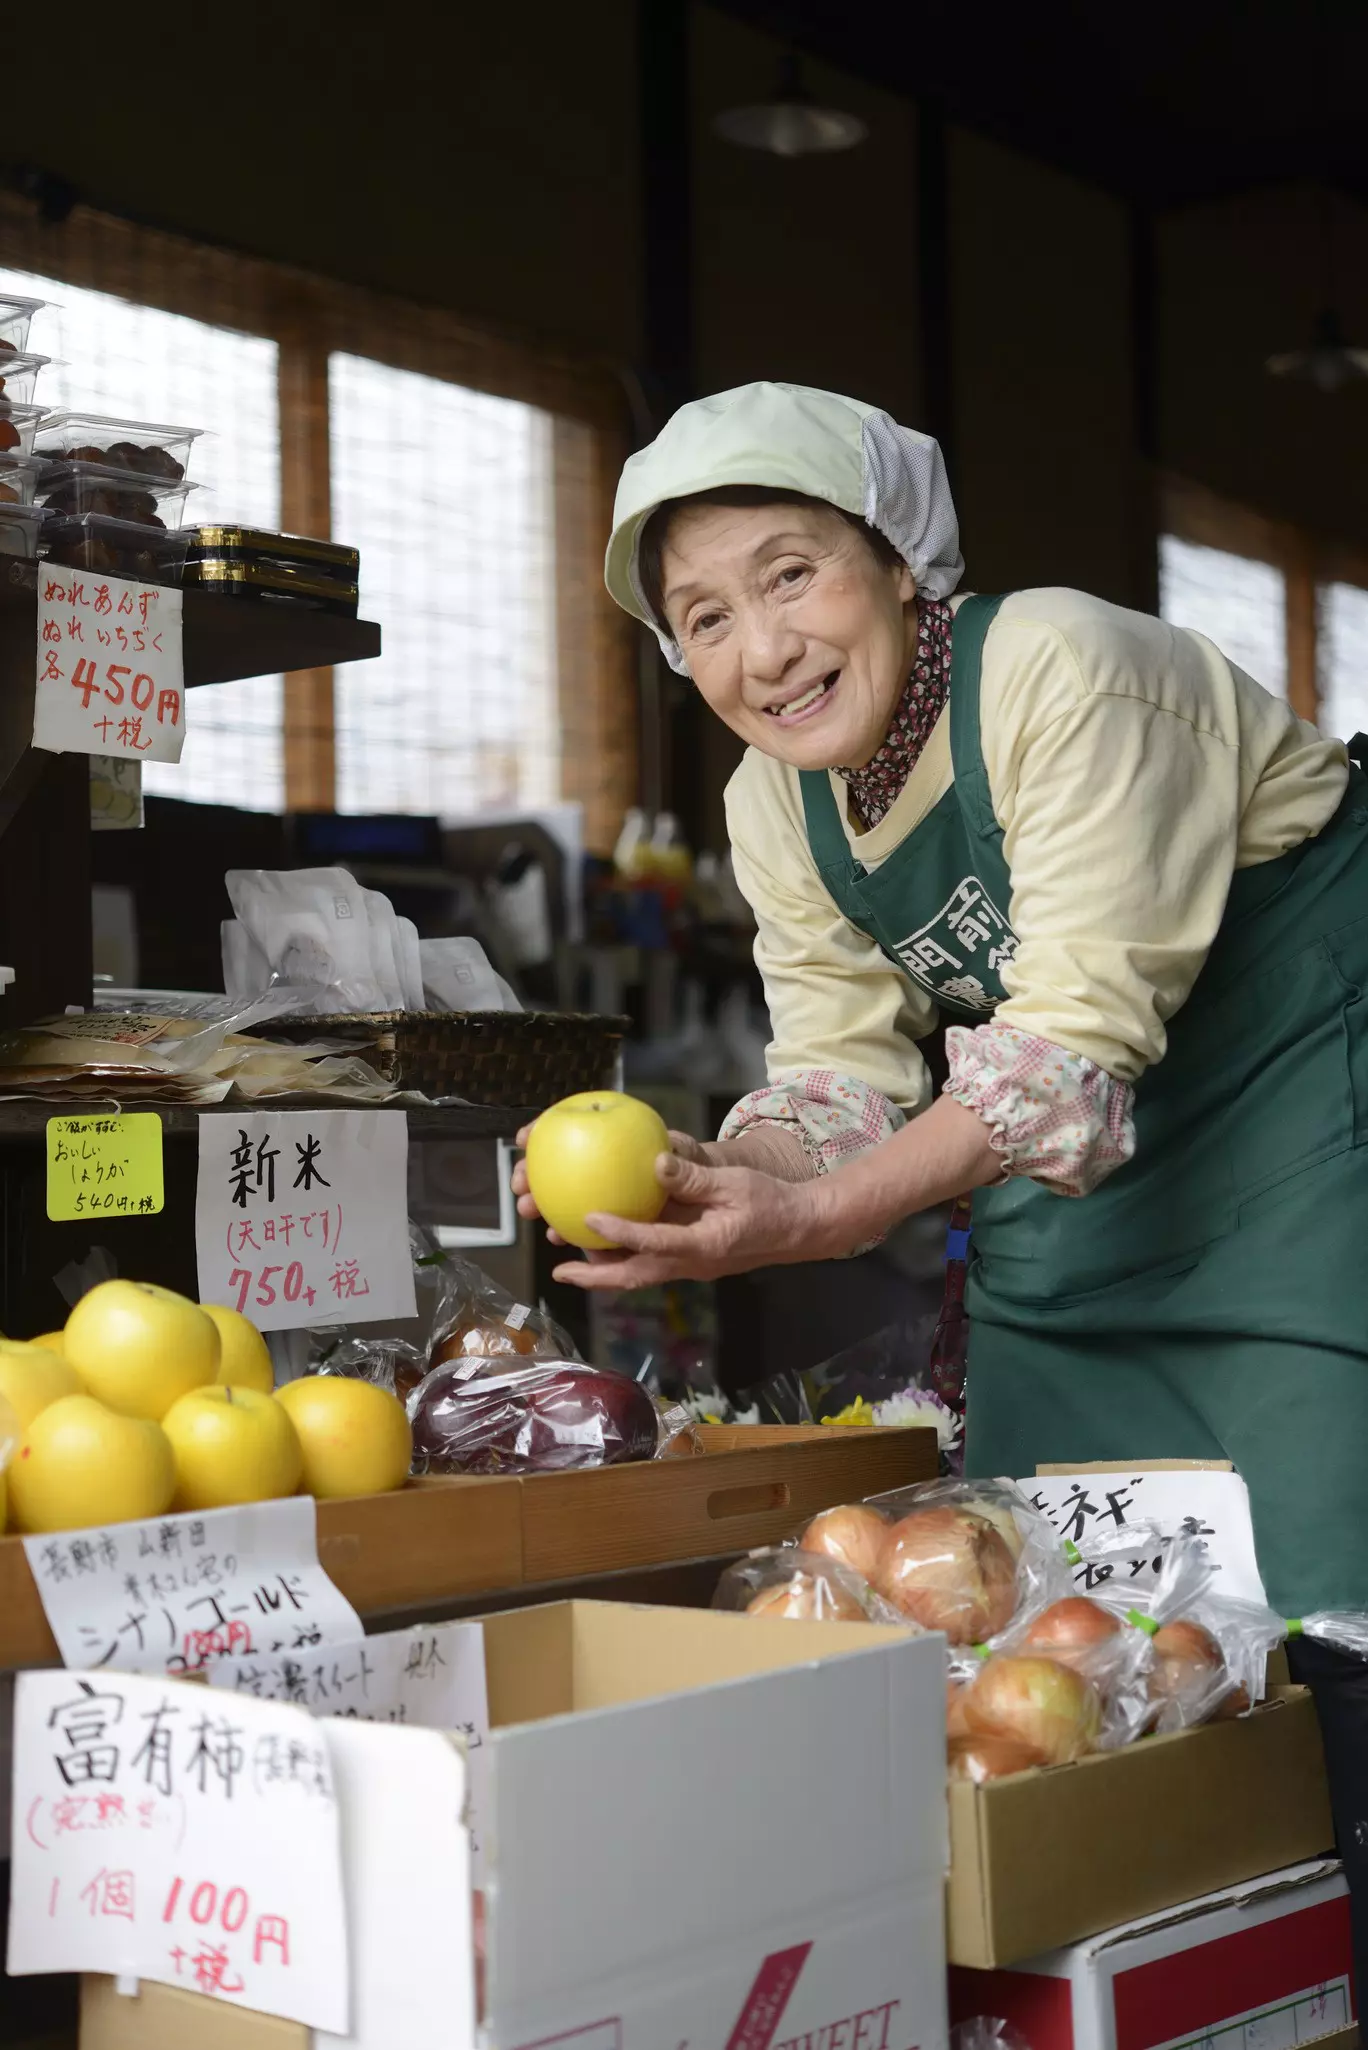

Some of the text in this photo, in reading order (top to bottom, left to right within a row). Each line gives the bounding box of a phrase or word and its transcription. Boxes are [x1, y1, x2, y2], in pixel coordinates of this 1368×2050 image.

[44, 582, 159, 625] ぬれあんず
[55, 1140, 101, 1162] おいしい
[71, 1159, 129, 1184] しょうが
[228, 1129, 332, 1209] 新米
[78, 1573, 311, 1668] シナノゴールド
[47, 1679, 245, 1801] 富有柿
[163, 1876, 290, 1966] 100円
